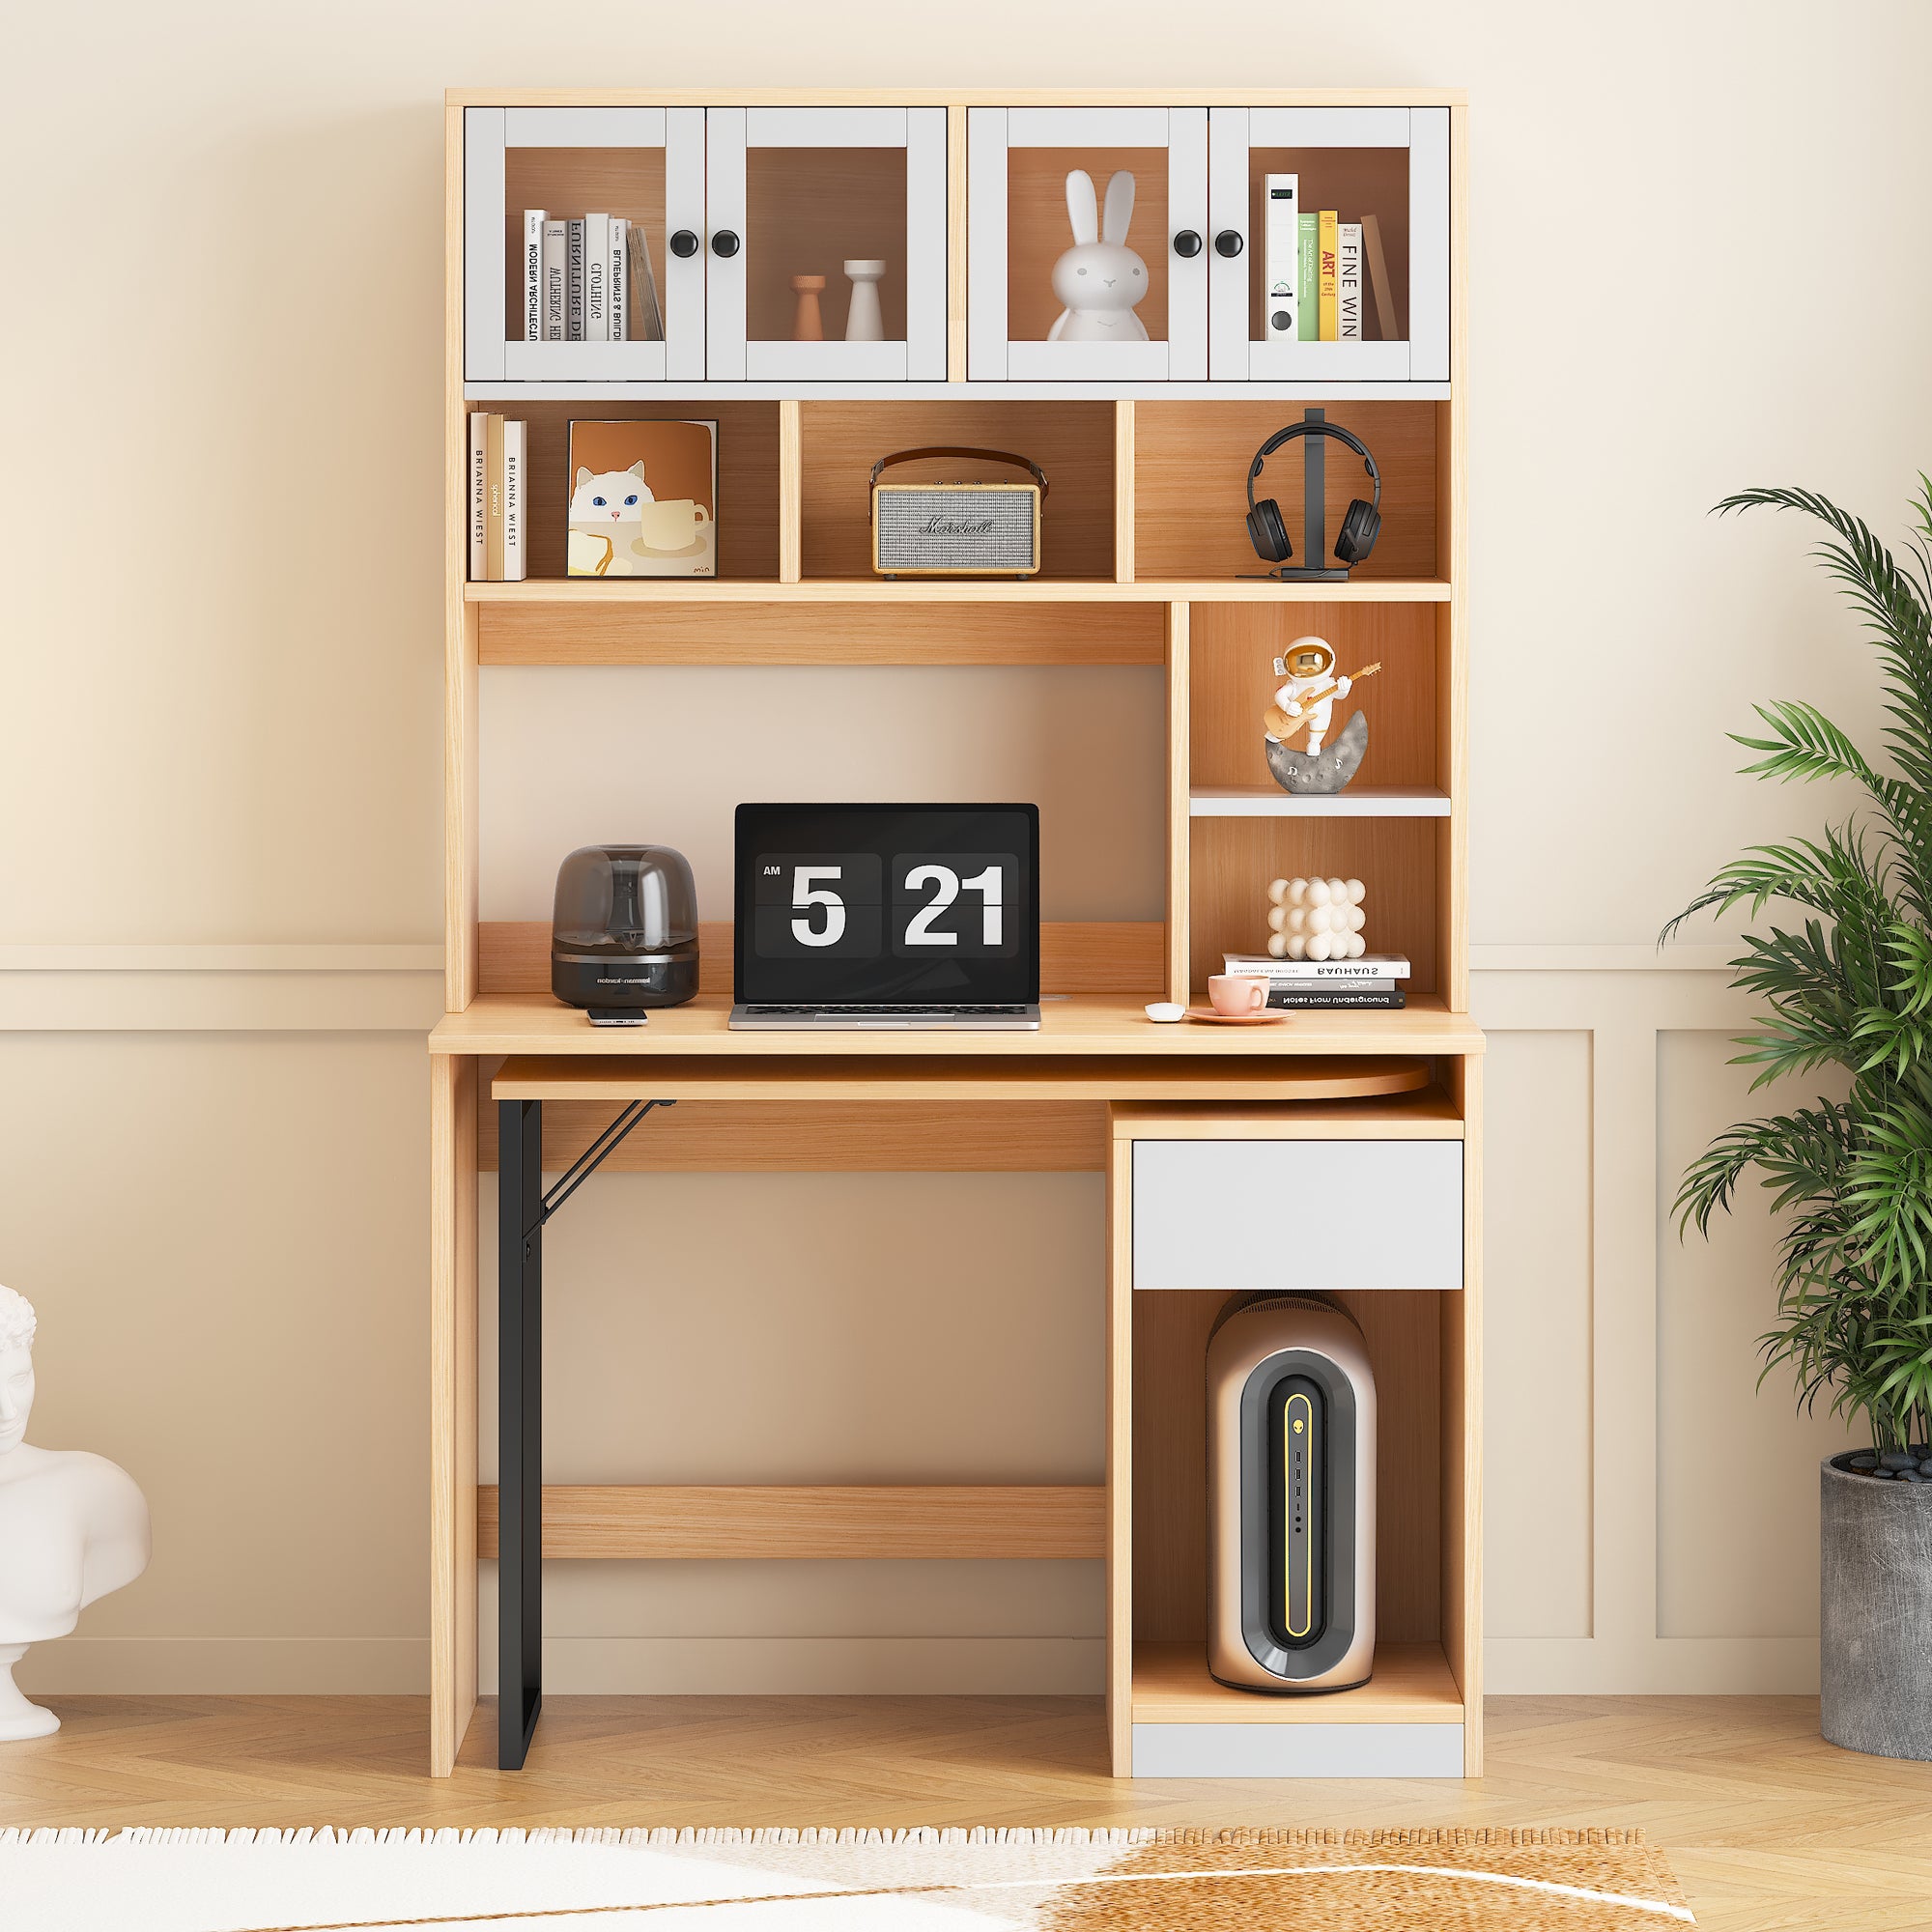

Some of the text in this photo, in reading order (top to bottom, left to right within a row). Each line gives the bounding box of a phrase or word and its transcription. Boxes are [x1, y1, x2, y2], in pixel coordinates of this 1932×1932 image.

[1321, 250, 1335, 277] ART
[1342, 245, 1357, 288] FINE
[1342, 296, 1357, 337] WIN
[919, 516, 995, 535] Marshall
[693, 565, 710, 574] min
[763, 866, 781, 876] AM
[790, 864, 1004, 948] 5 21
